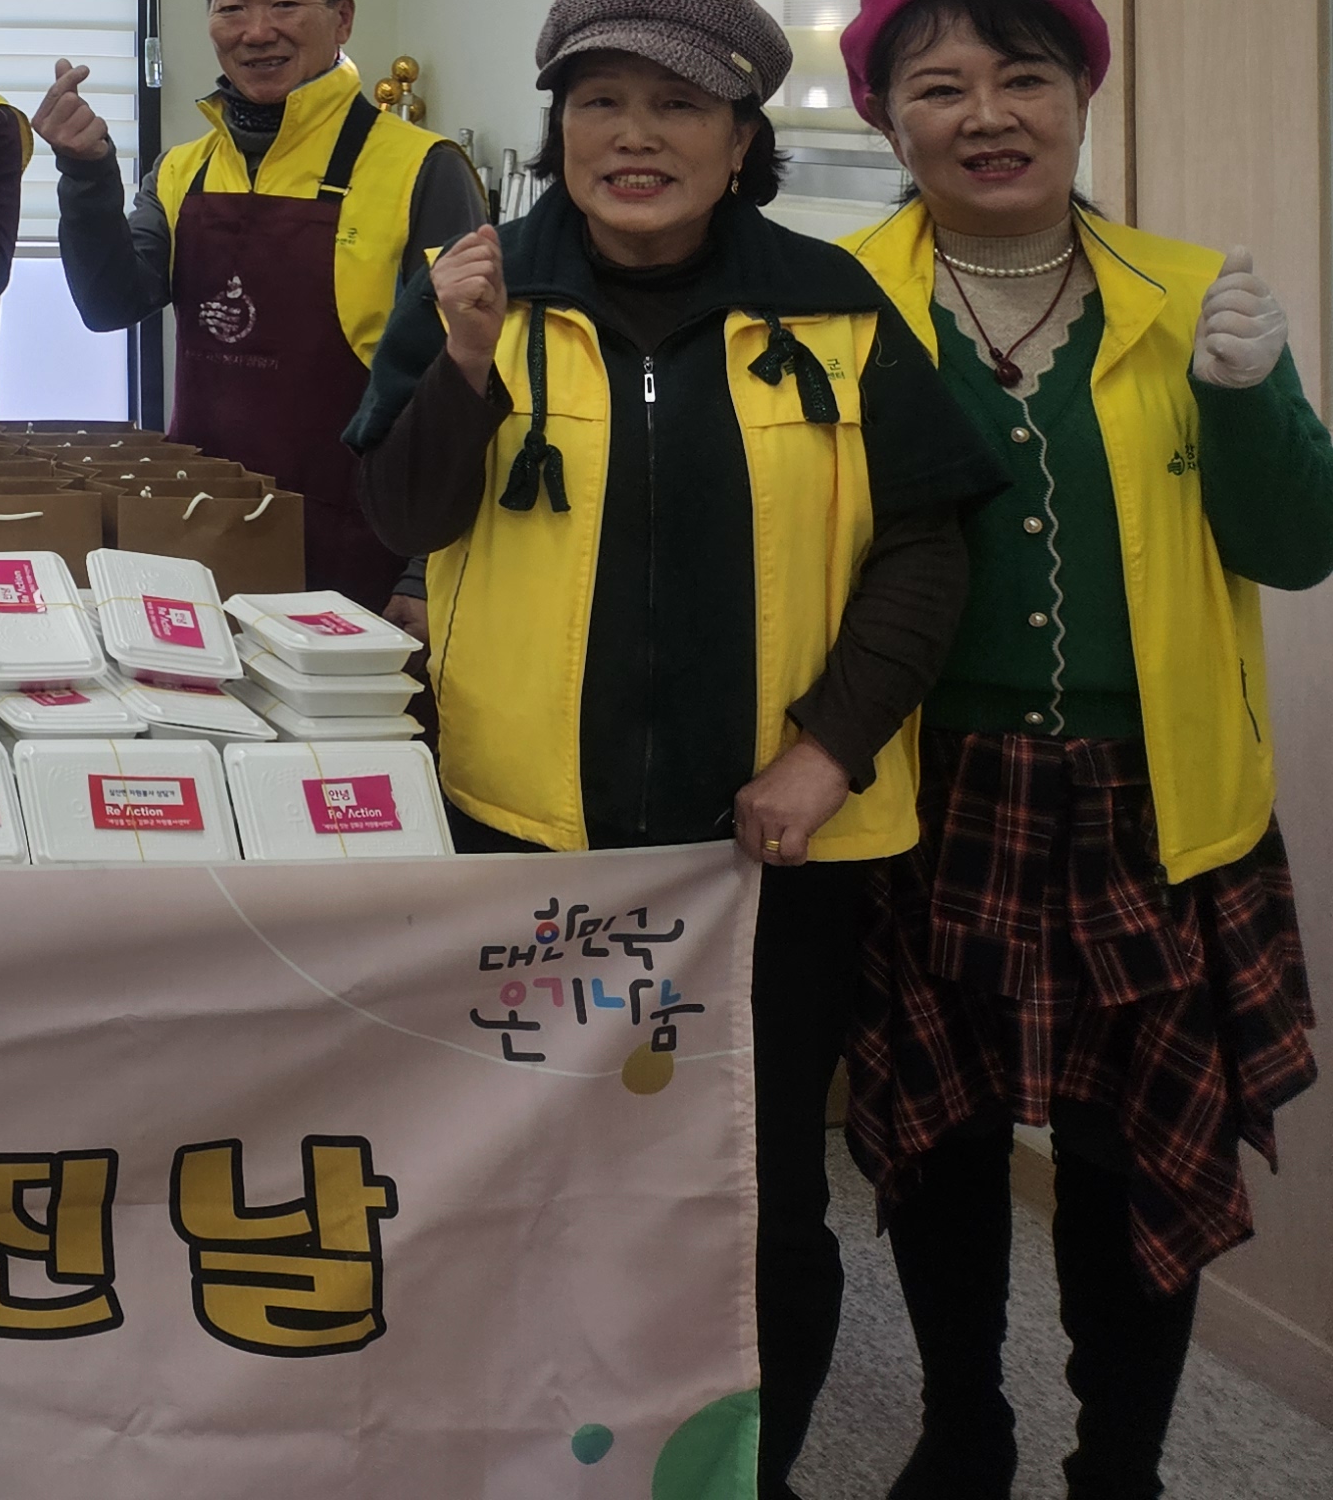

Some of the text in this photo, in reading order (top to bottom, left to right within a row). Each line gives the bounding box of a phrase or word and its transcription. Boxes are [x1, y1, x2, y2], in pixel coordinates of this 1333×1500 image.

[129, 789, 154, 797] 자원봉사
[156, 789, 175, 798] 상담가
[329, 789, 350, 801] 안녕
[105, 805, 164, 816] Re Action
[348, 808, 382, 818] Action
[479, 897, 684, 971] 대한민국
[470, 977, 705, 1062] 온기나눔
[169, 1135, 398, 1359] 날
